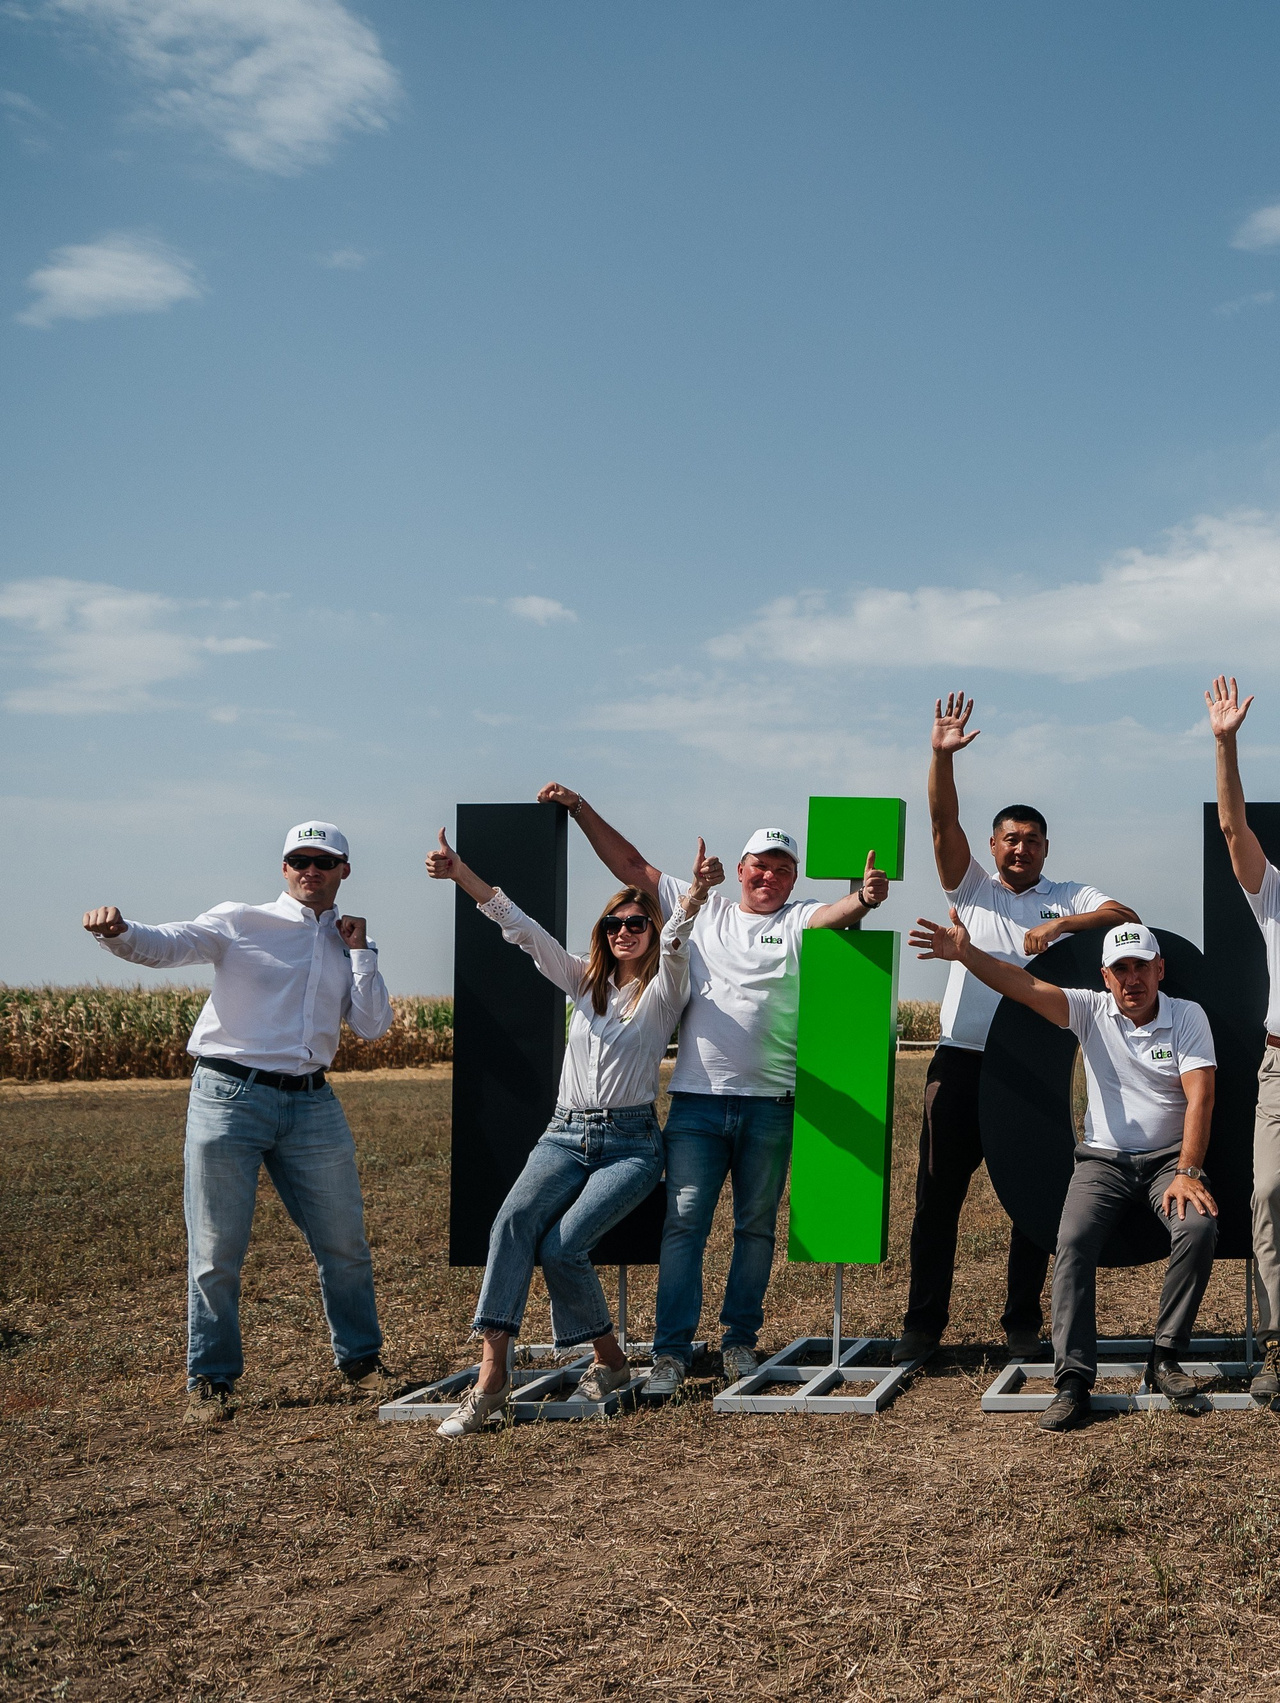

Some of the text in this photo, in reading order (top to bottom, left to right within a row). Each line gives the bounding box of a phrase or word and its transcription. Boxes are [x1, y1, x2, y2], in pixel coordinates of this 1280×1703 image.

[298, 828, 326, 838] Lidea
[761, 936, 783, 944] Lidea
[1115, 932, 1140, 944] Lidea
[1151, 1049, 1173, 1060] Lidea
